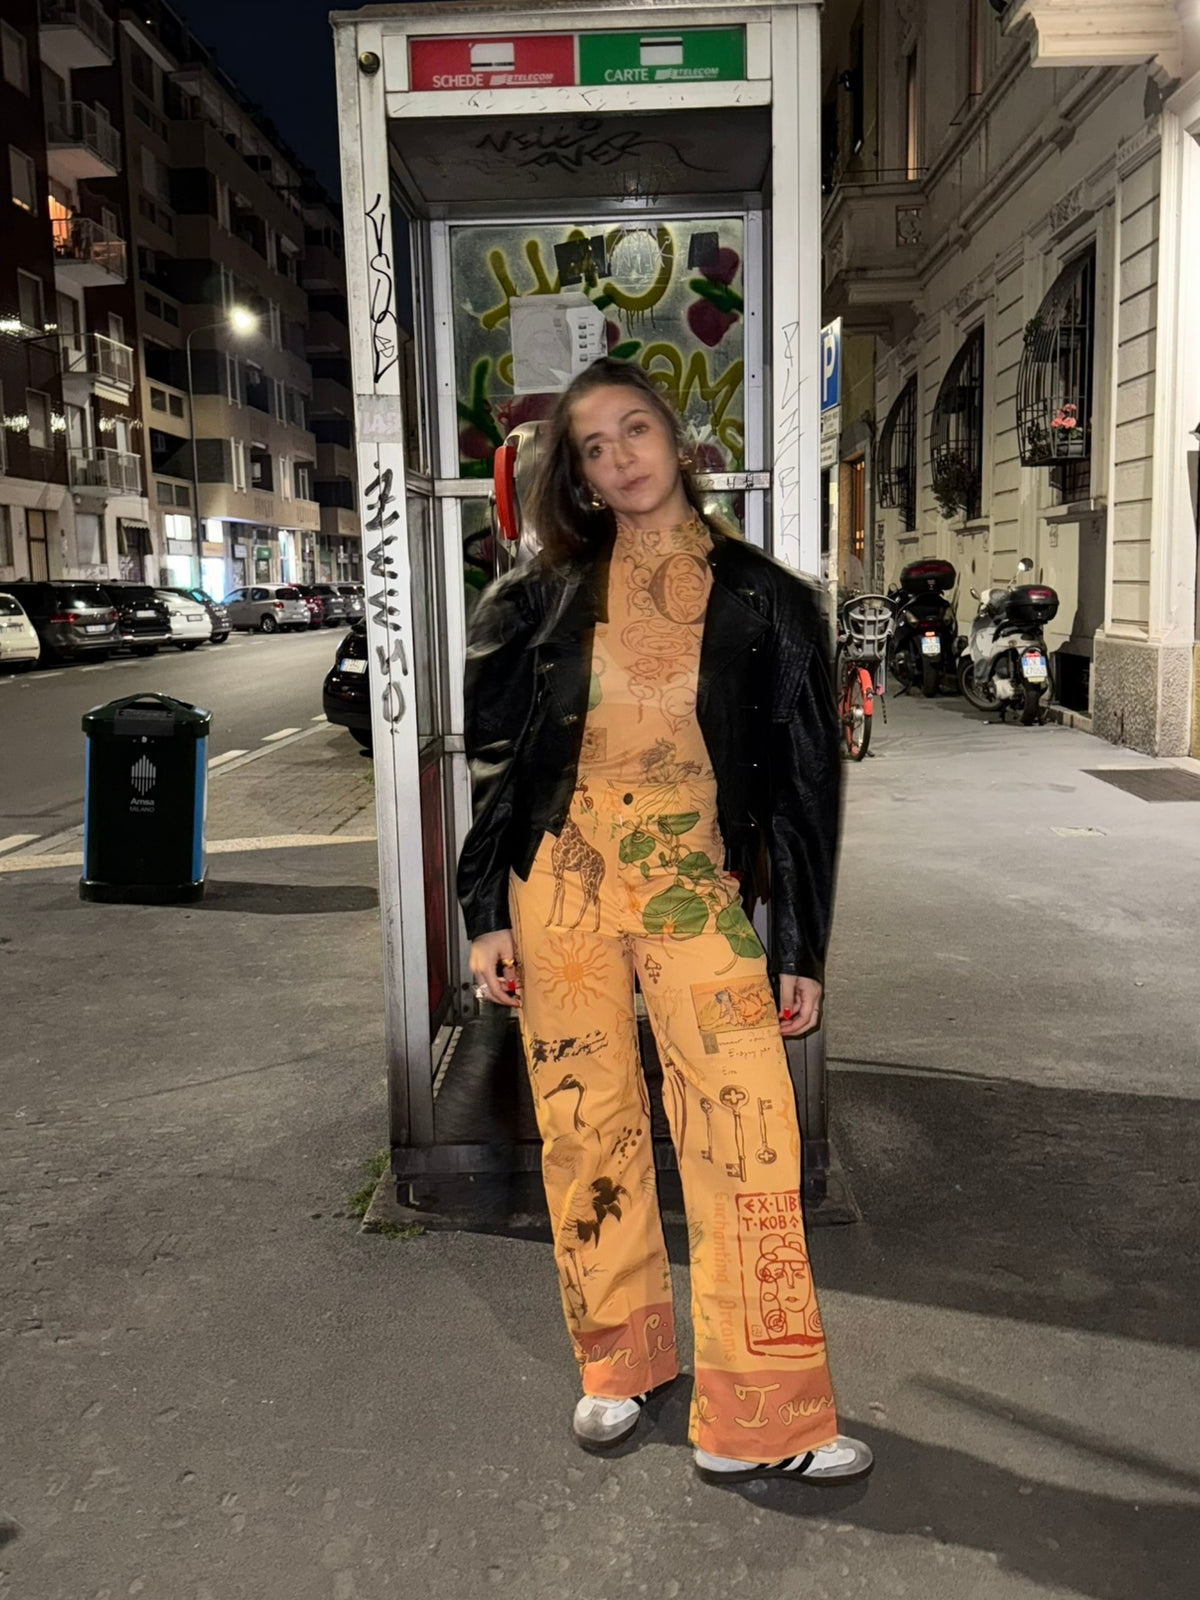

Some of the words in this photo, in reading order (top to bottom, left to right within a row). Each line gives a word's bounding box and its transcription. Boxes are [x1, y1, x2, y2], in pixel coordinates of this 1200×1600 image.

[432, 74, 484, 89] SCHEDE
[512, 73, 554, 81] TELECOM
[604, 68, 649, 82] CARTE
[677, 67, 719, 76] TELECOM
[823, 334, 837, 402] P
[130, 797, 155, 806] Amsa
[129, 806, 155, 814] MILANO
[718, 1299, 737, 1363] Dreams
